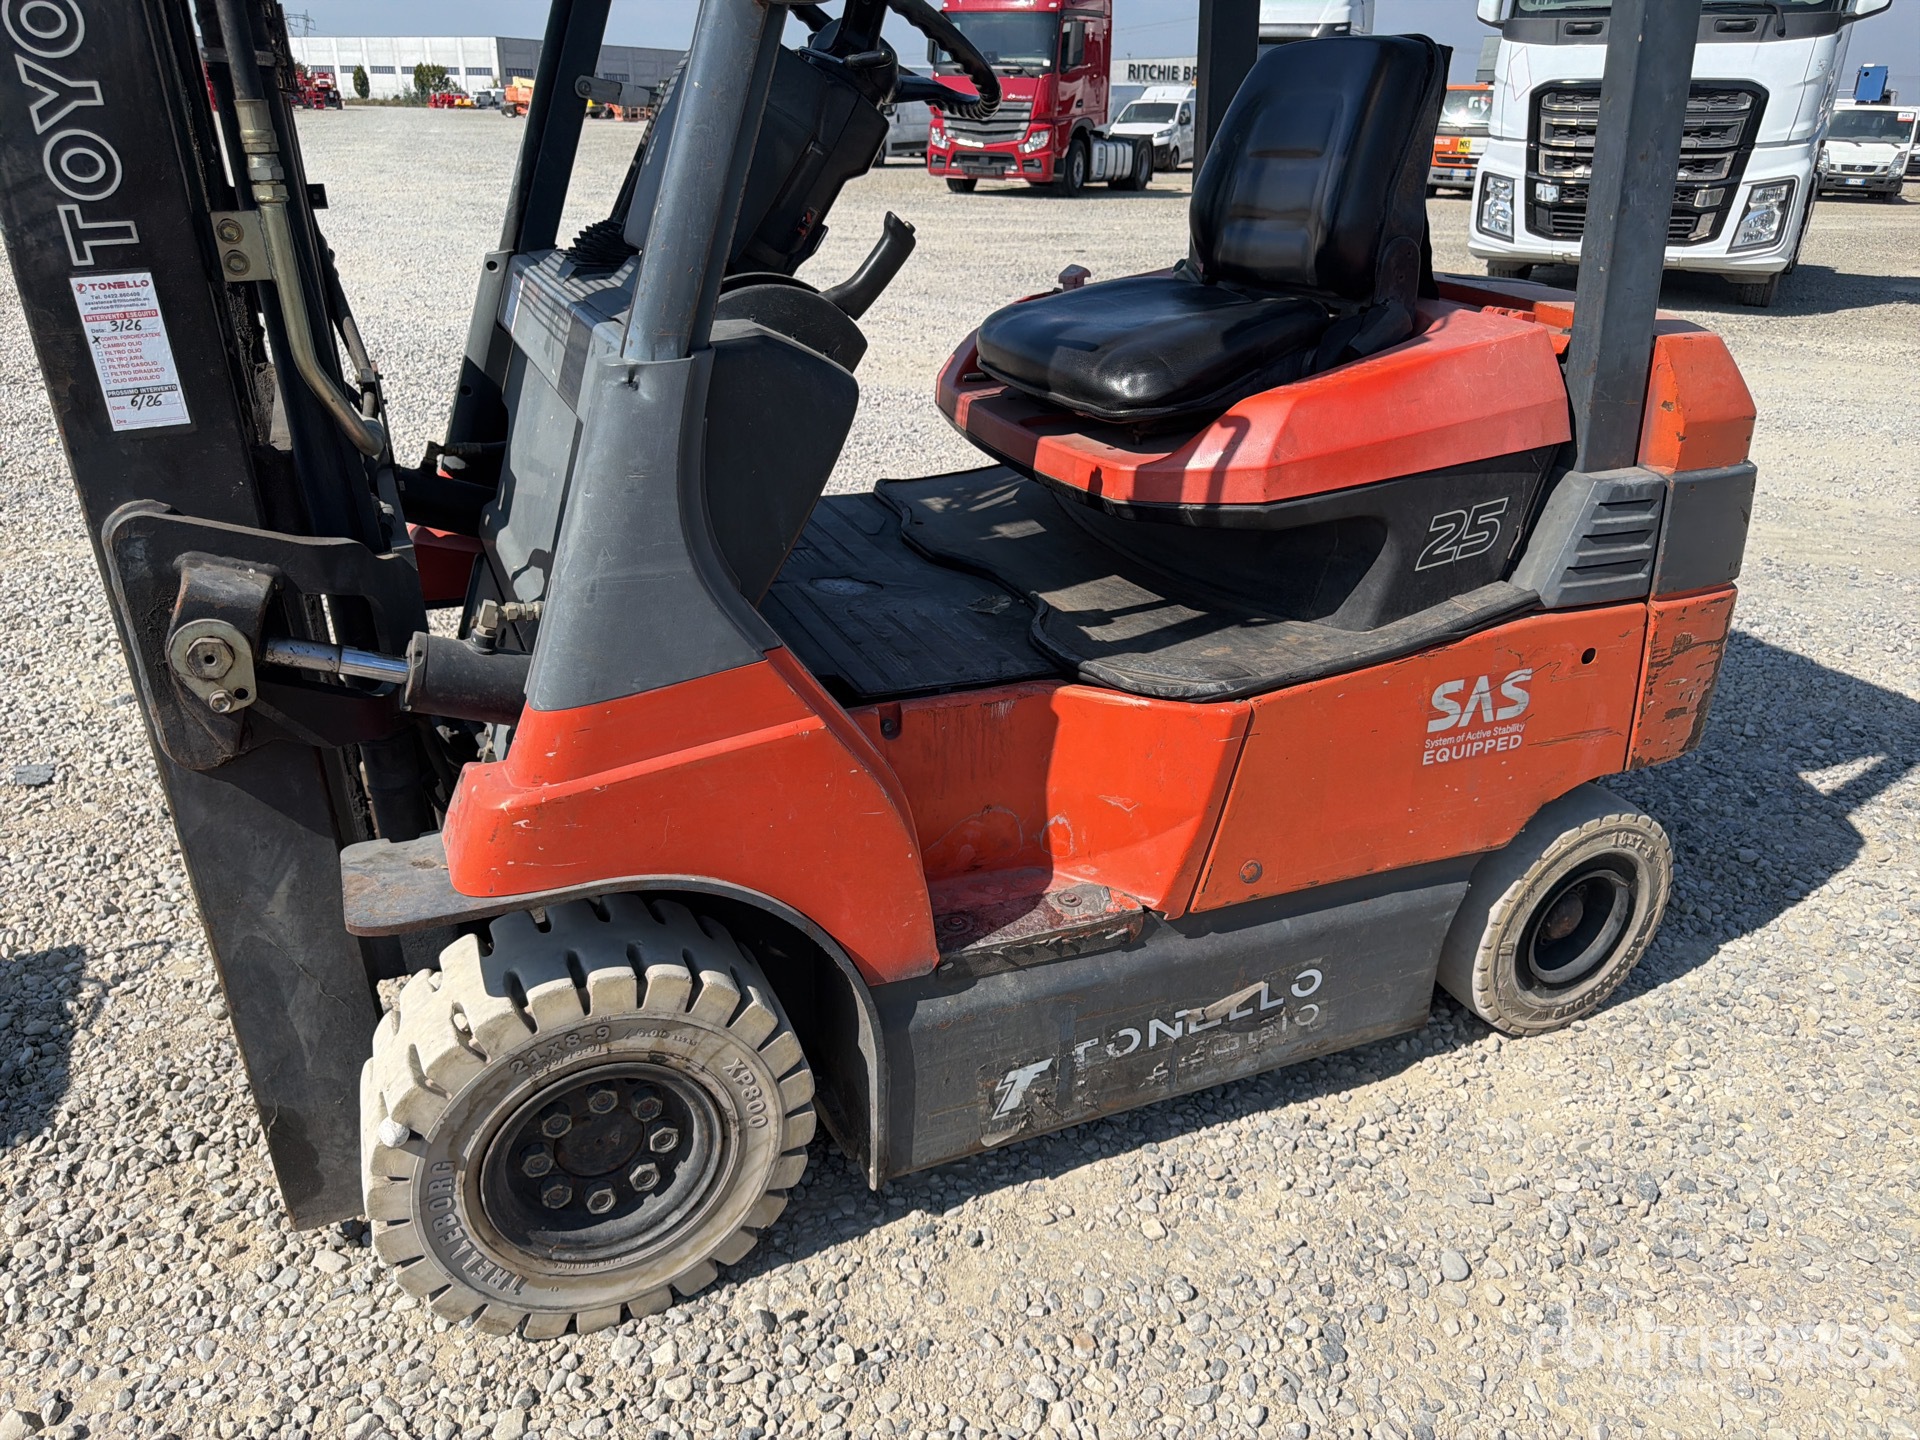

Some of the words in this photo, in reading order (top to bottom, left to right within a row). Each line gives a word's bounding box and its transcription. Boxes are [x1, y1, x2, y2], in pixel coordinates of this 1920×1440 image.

[1128, 63, 1180, 80] RITCHIE
[88, 279, 150, 292] TONELLO
[86, 312, 125, 321] INTERVENTO
[126, 310, 157, 318] ESEGUITO
[109, 319, 143, 333] 3/26
[131, 360, 158, 369] GASOLIO
[132, 366, 165, 376] IDRAULICO
[128, 374, 161, 383] IDRAULICO
[107, 388, 139, 398] PROSSIMO
[140, 385, 177, 394] INTERVENTO
[130, 394, 163, 411] 6/26
[1415, 497, 1509, 571] 25
[1427, 668, 1533, 733] SAS
[1424, 736, 1455, 749] System
[1456, 733, 1465, 743] of
[1466, 729, 1492, 741] Active
[1492, 723, 1526, 736] Stability
[1422, 735, 1522, 766] EQUIPPED
[722, 1057, 769, 1130] XP800
[428, 1160, 529, 1296] TRELLEBORG
